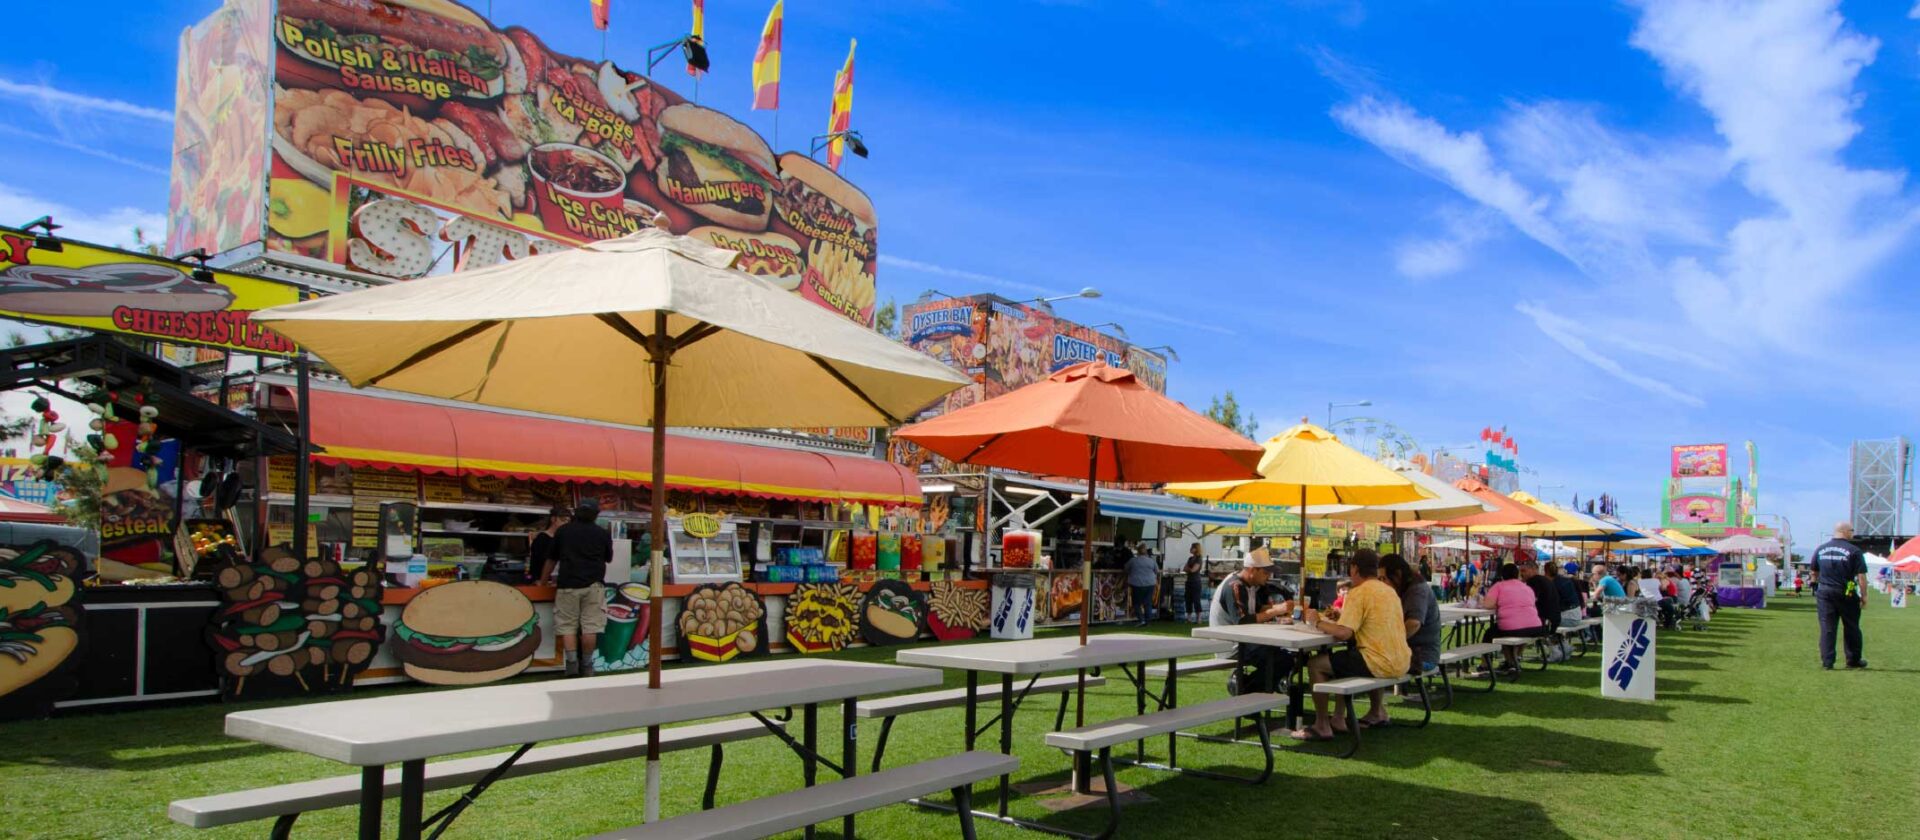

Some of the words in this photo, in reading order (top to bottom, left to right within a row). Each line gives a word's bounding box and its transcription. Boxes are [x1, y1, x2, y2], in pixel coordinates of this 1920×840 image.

[284, 22, 373, 69] Polish
[382, 49, 402, 71] &
[408, 52, 489, 96] Italian
[340, 65, 451, 100] Sausage
[563, 80, 634, 139] Sausage
[333, 136, 406, 177] Frilly
[409, 138, 476, 171] Fries
[546, 181, 586, 216] Ice
[590, 201, 638, 232] Cold
[667, 177, 765, 204] Hamburgers
[789, 211, 870, 260] Cheesesteak
[817, 212, 856, 233] Philly
[0, 233, 33, 264] Y
[710, 231, 751, 256] Hot
[749, 238, 797, 264] Dogs
[809, 269, 842, 310] French
[912, 310, 950, 333] OYSTER
[951, 306, 973, 326] BAY
[1054, 333, 1097, 362] OYSTER
[1608, 618, 1650, 691] SRP
